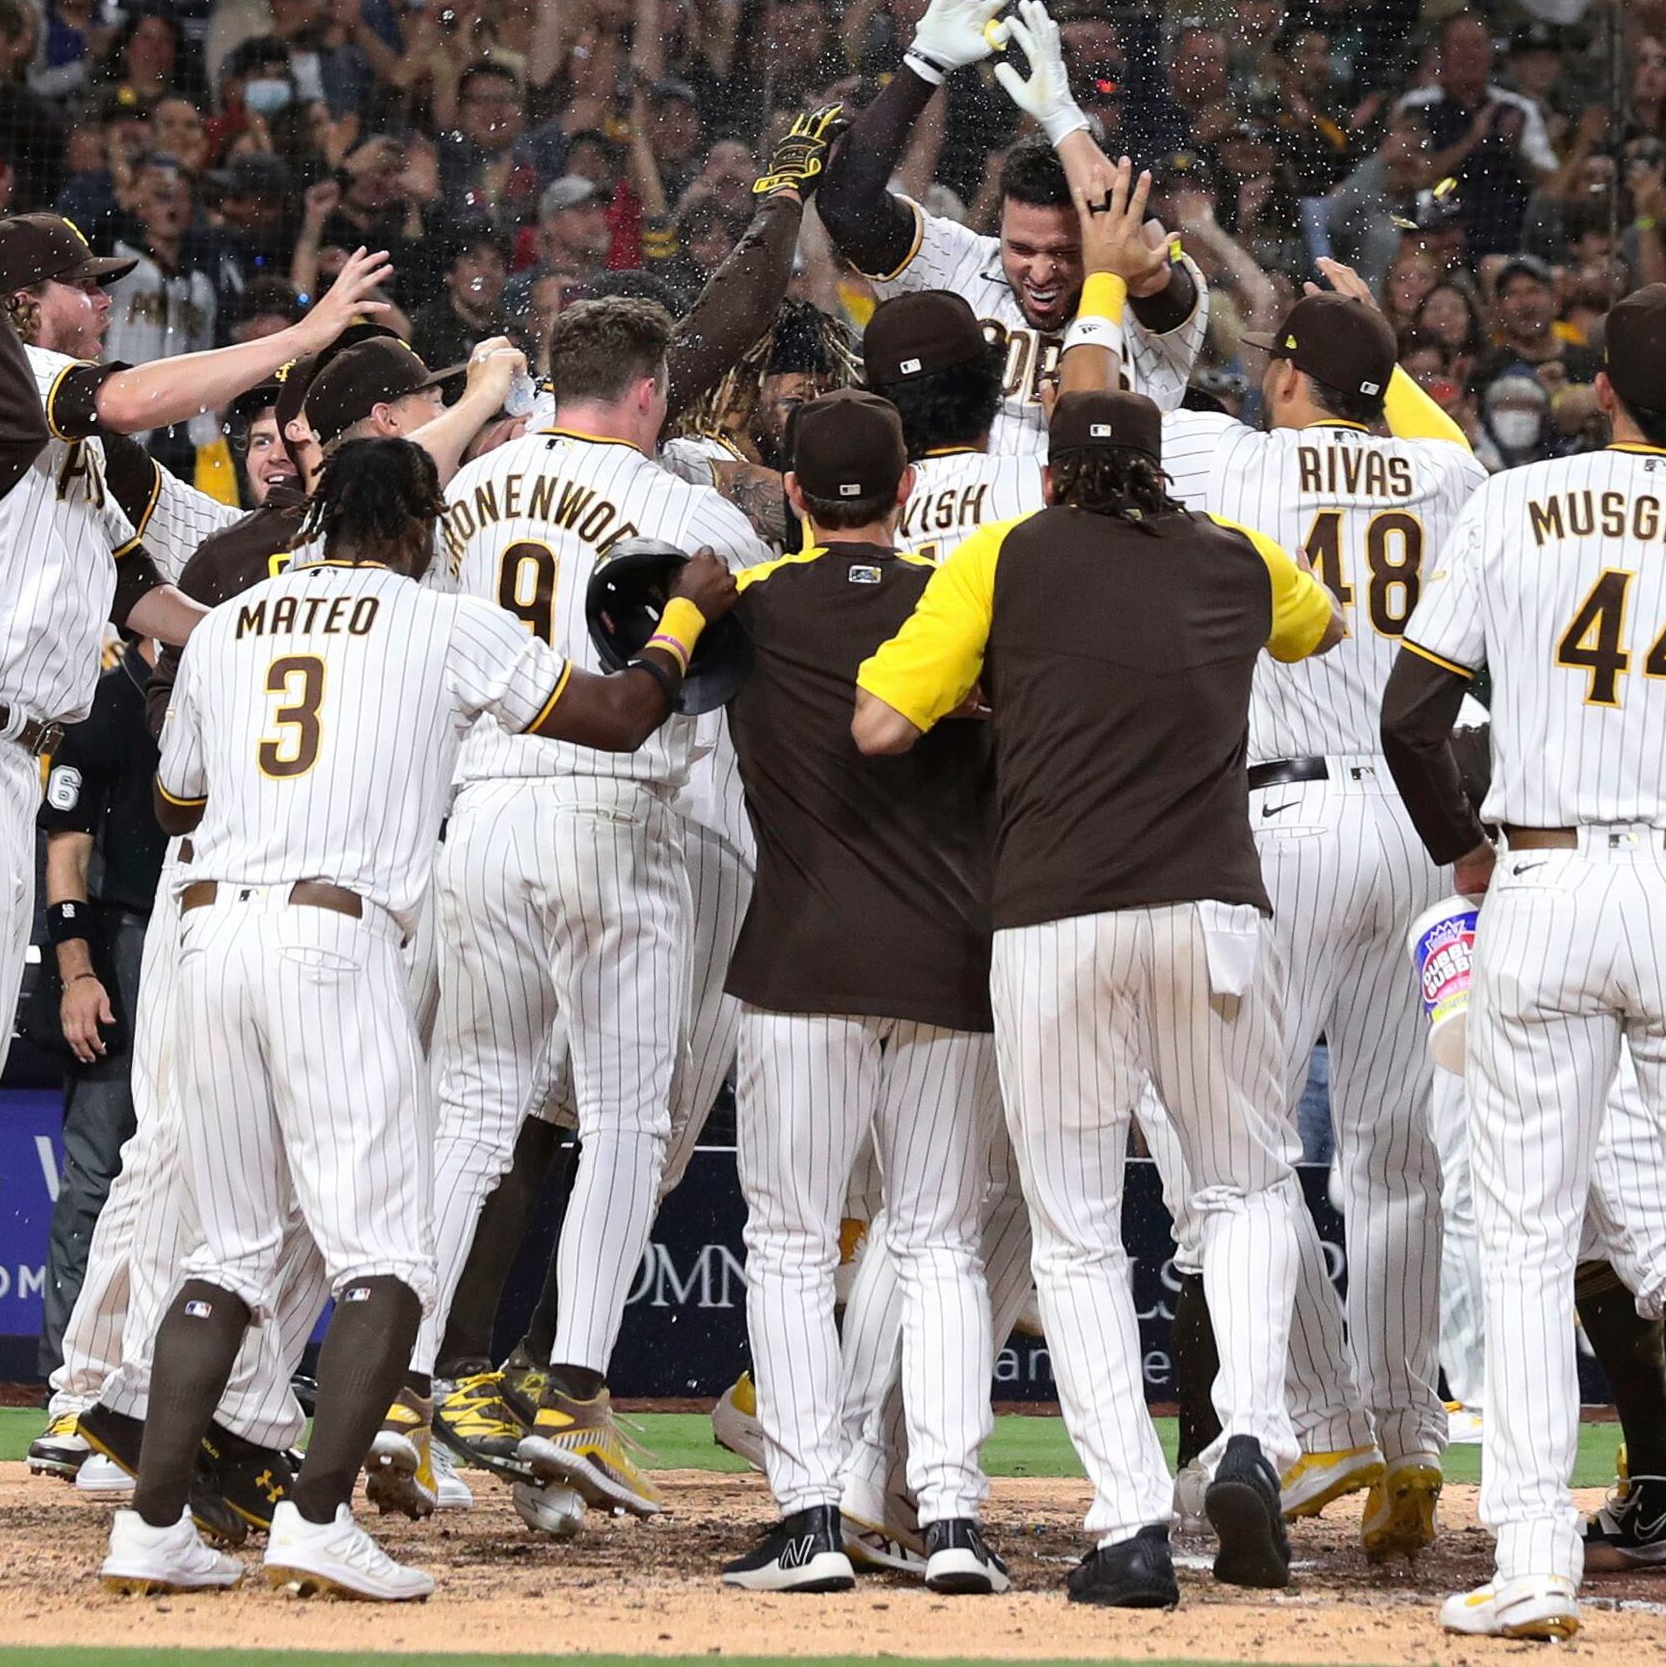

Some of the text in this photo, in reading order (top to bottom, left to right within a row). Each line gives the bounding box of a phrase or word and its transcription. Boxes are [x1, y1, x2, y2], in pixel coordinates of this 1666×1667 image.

[1297, 445, 1413, 497] RIVAS
[496, 538, 557, 649] 9
[1300, 509, 1425, 639] 48
[235, 596, 381, 640] MATEO
[254, 652, 328, 782] 3
[46, 764, 83, 813] 6
